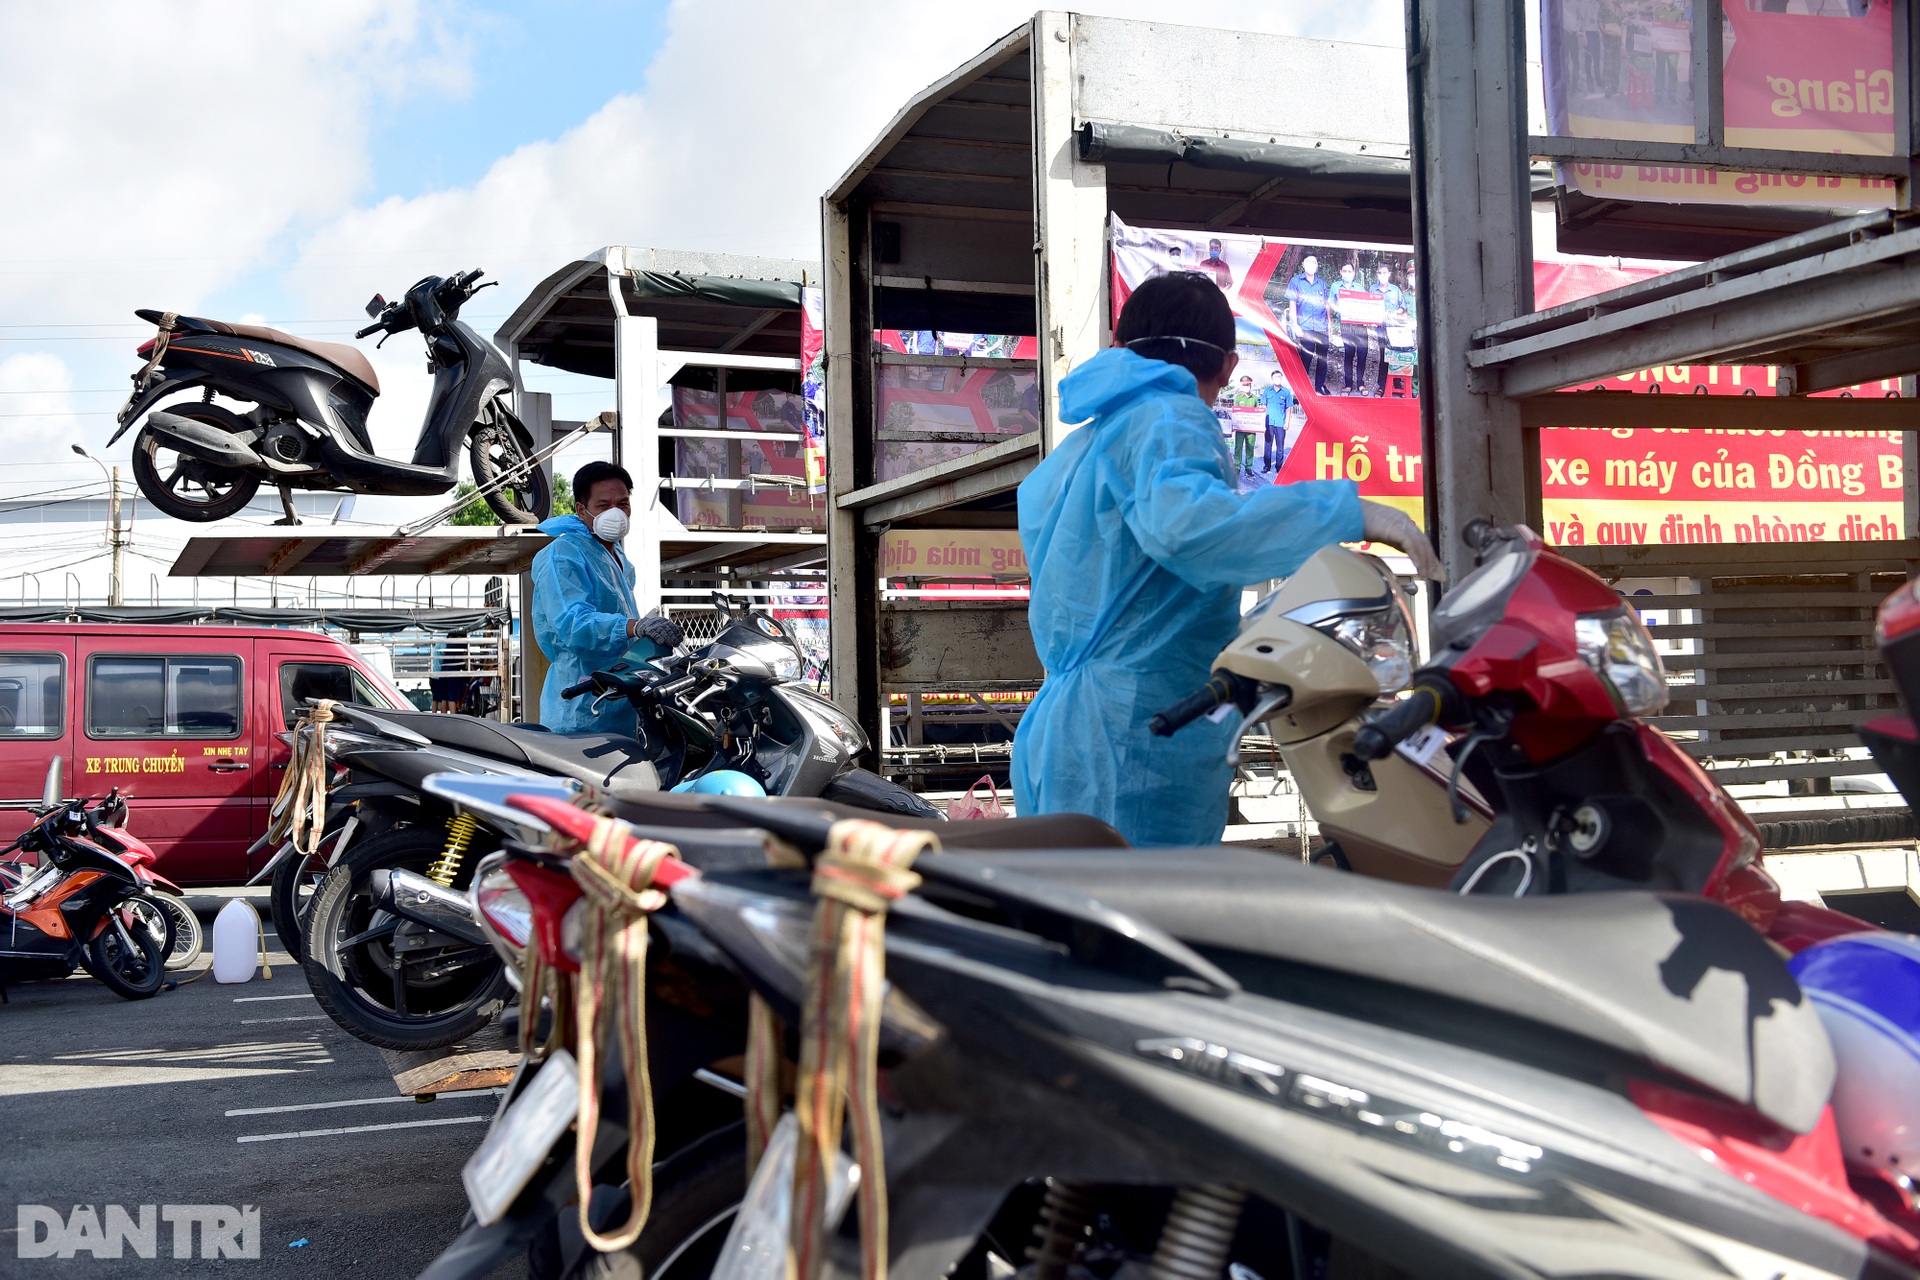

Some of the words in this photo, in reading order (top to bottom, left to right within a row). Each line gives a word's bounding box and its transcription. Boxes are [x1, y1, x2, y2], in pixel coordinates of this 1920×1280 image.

[1316, 435, 1371, 482] Hỗ
[1386, 445, 1422, 482] tr
[1545, 458, 1590, 486] xe
[1605, 451, 1677, 494] máy
[1691, 448, 1756, 489] của
[1768, 449, 1866, 496] Đồng
[1877, 454, 1904, 489] B
[1549, 514, 1585, 545] và
[86, 757, 101, 773] XE
[104, 757, 140, 773] TRUNG
[142, 749, 185, 773] CHUYỂN
[203, 747, 216, 756] XIN
[217, 747, 232, 757] NHẸ
[234, 747, 248, 756] TAY
[813, 754, 837, 764] HONDA
